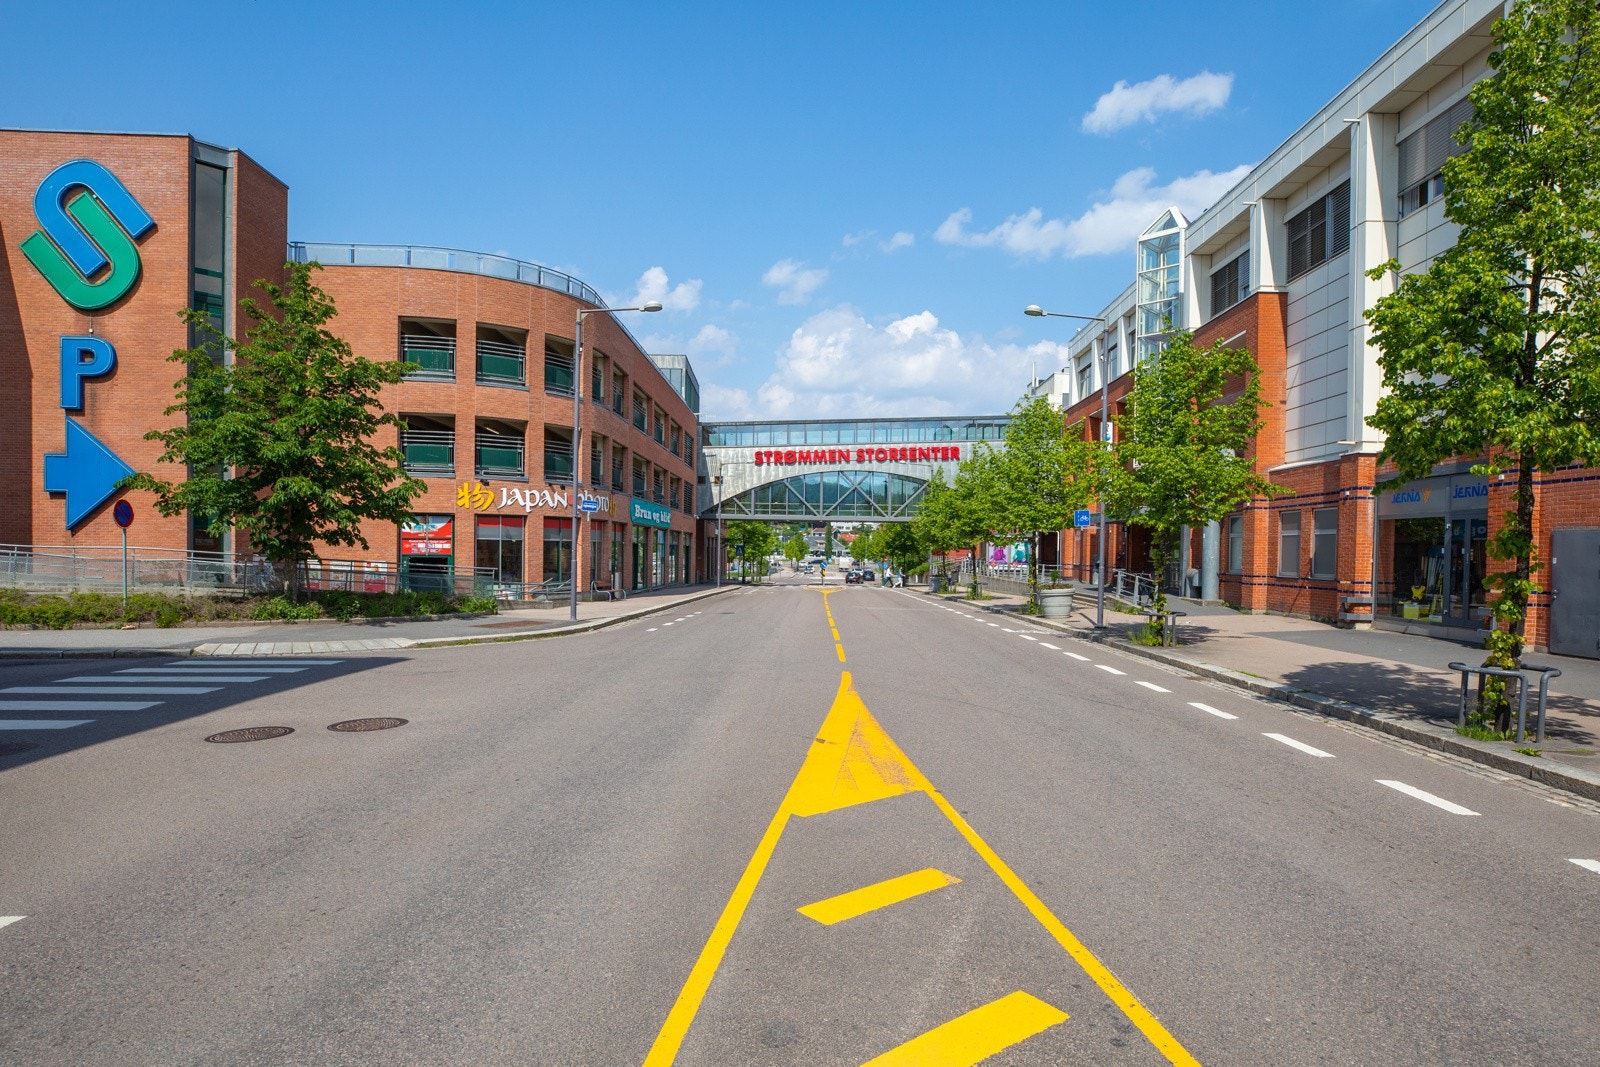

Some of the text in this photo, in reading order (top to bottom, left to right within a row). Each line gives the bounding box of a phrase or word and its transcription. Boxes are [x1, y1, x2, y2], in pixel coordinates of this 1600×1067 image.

[60, 336, 117, 410] P
[754, 446, 960, 466] STRØMMEN STORSENTER
[634, 504, 652, 520] Brun
